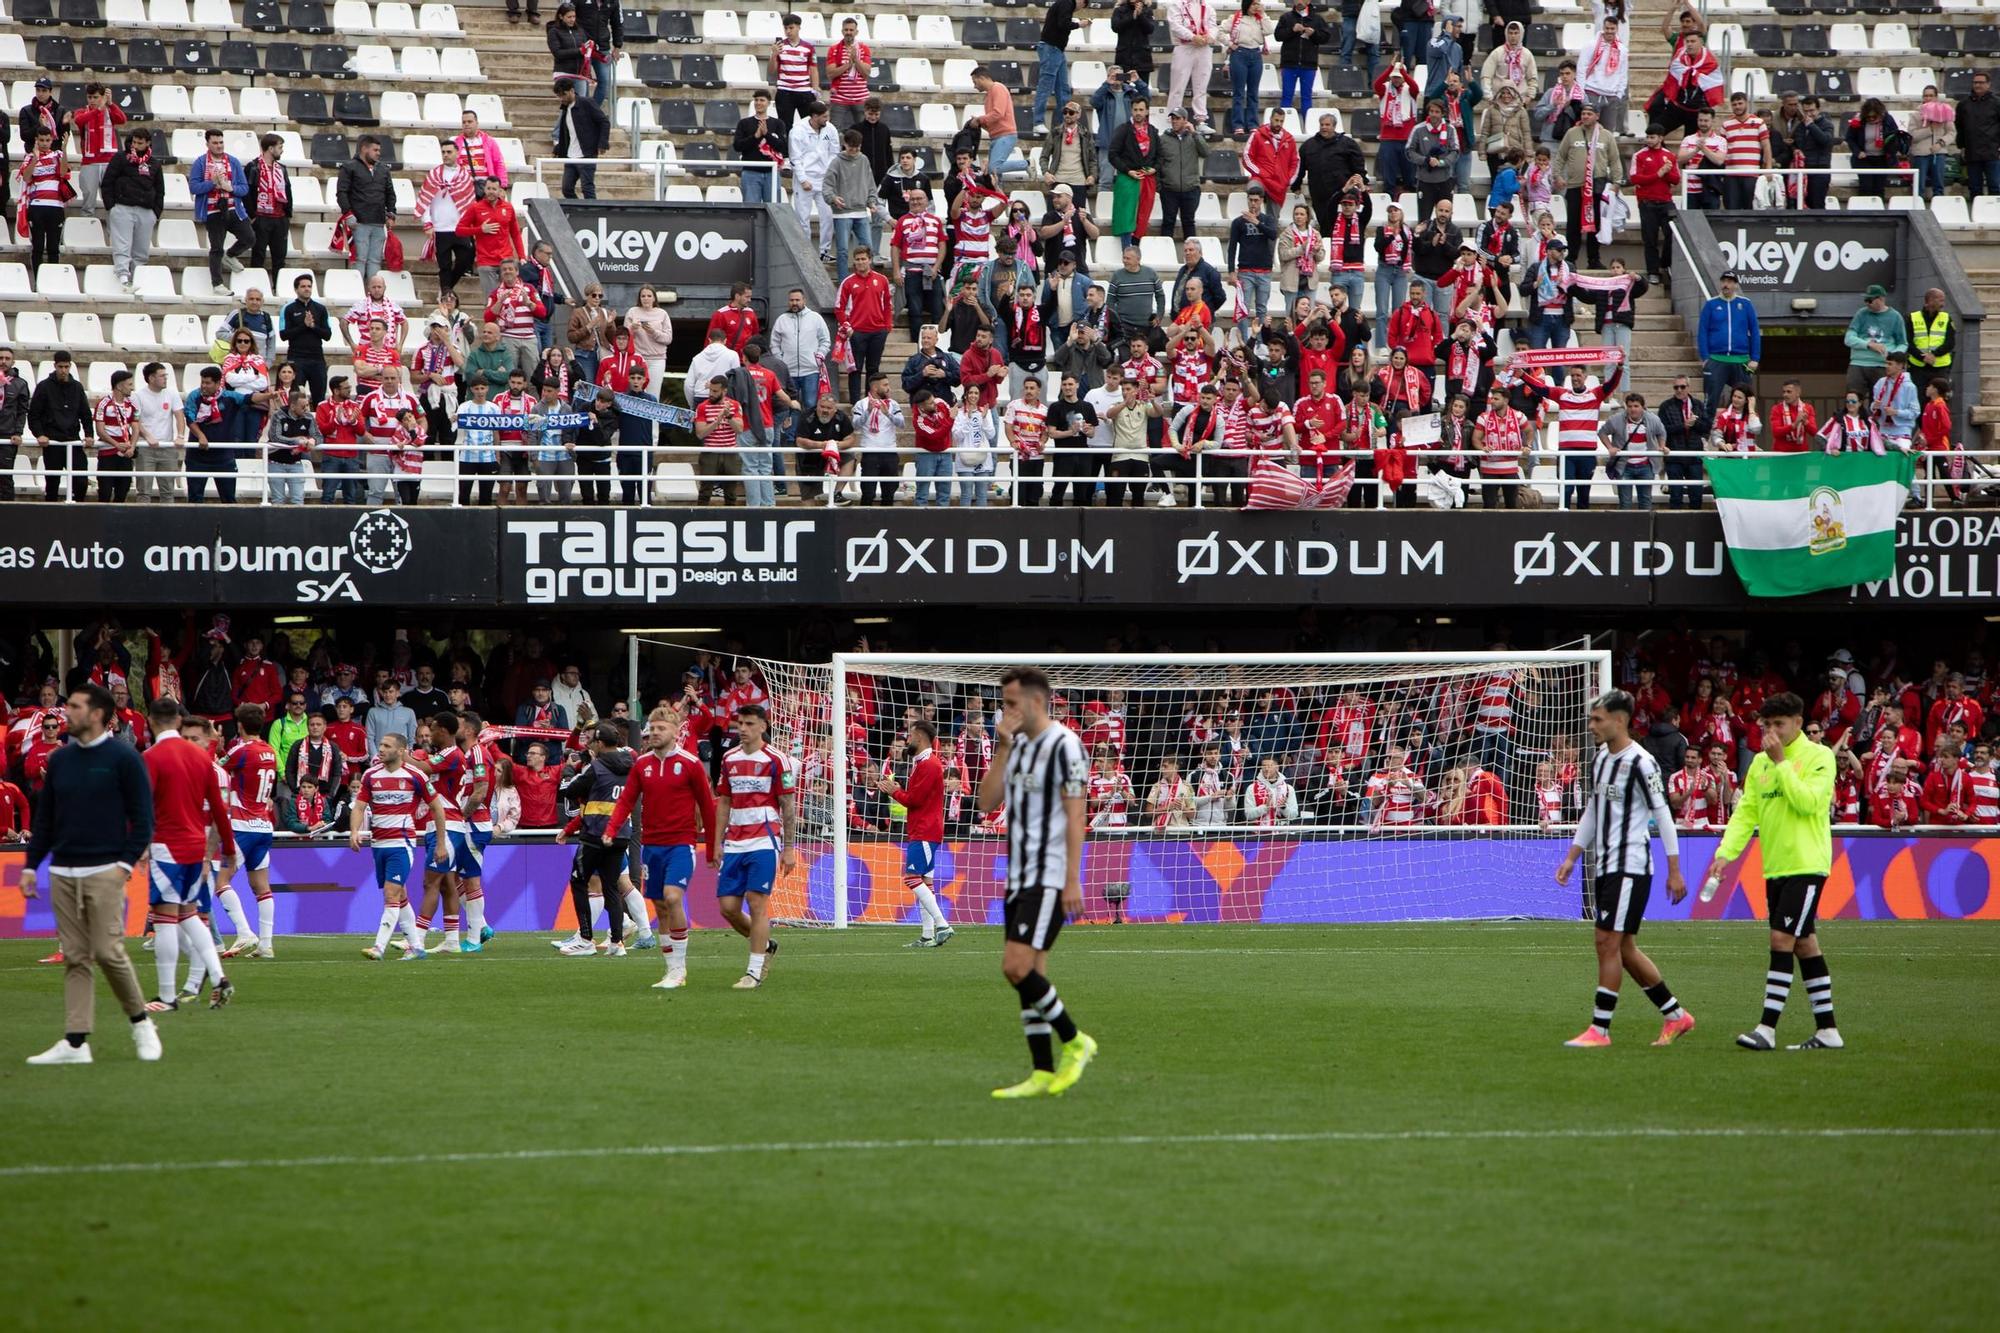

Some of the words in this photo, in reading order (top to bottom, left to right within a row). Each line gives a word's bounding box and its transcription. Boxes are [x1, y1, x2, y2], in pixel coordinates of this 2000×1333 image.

[574, 217, 669, 272] okey
[1718, 228, 1809, 284] okey
[598, 262, 640, 272] Viviendas
[1737, 274, 1779, 285] Viviendas
[1565, 352, 1598, 360] GRANADA
[466, 415, 523, 428] FONDO
[549, 413, 583, 426] SUR
[44, 540, 125, 569] Auto
[144, 537, 348, 572] ambumar
[507, 510, 815, 564] Talasur
[847, 529, 1115, 582] ØXIDUM
[1177, 531, 1444, 583] ØXIDUM
[1514, 532, 1723, 585] ØXIDU
[526, 567, 677, 604] group
[682, 568, 738, 587] Design
[741, 569, 756, 583] &
[758, 568, 797, 583] Build
[256, 769, 276, 803] 16
